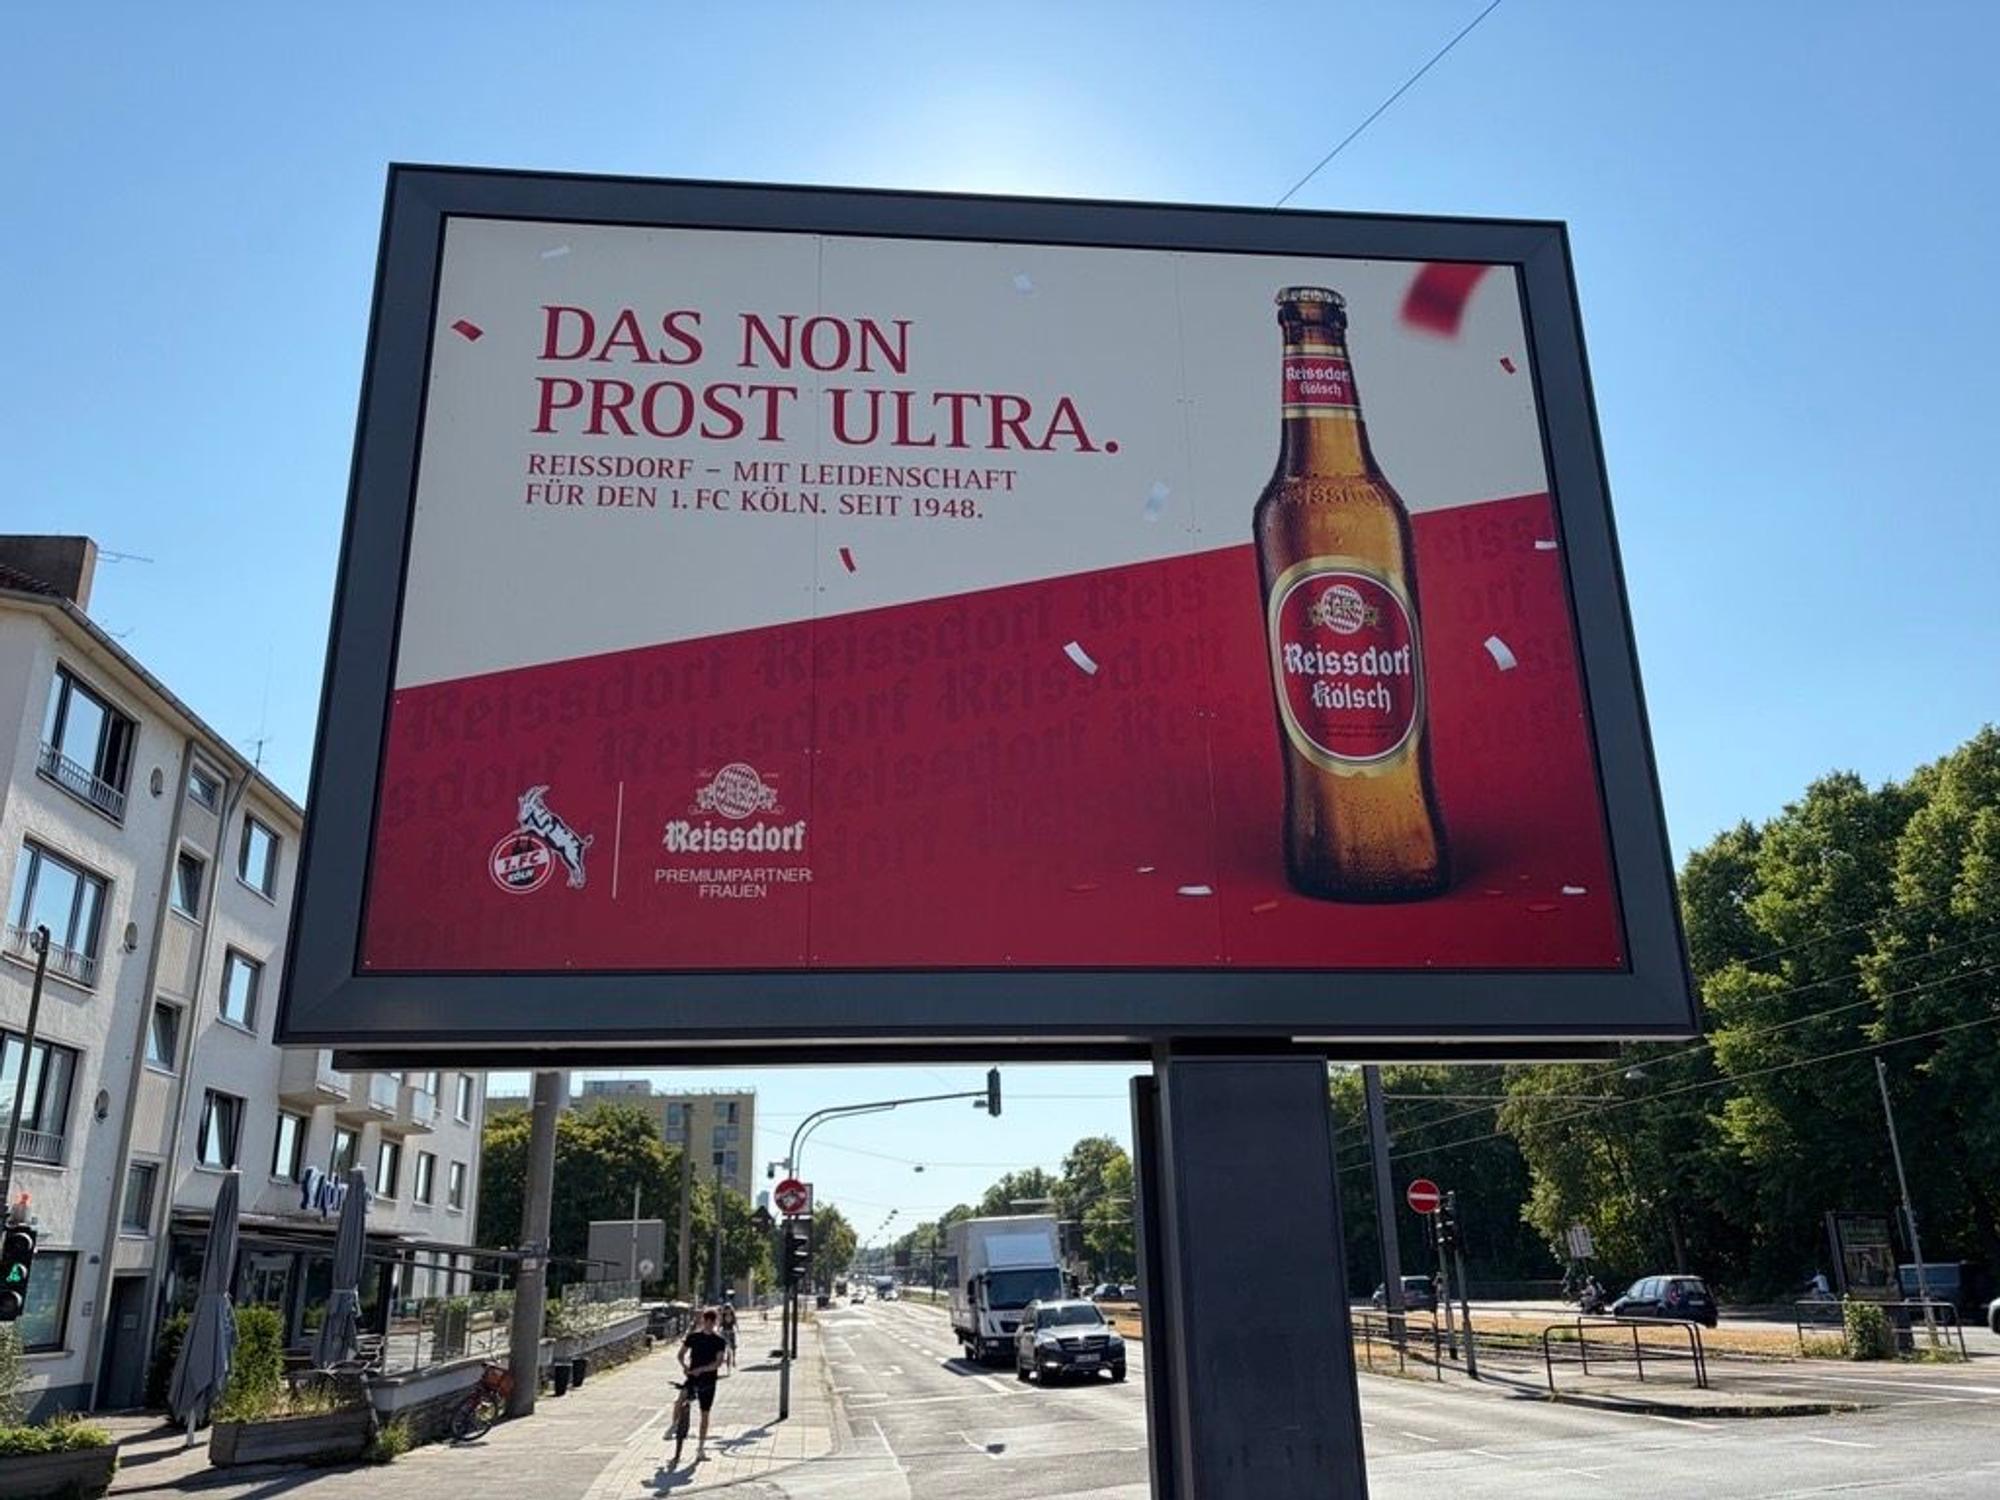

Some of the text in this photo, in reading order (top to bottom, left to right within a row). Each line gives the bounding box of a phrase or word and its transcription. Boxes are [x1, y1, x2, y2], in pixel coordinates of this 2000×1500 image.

[537, 304, 912, 374] DAS NON
[529, 376, 1121, 454] PROST ULTRA.
[527, 453, 694, 480] REISSDORF
[734, 460, 790, 483] MIT
[800, 463, 1017, 491] LEIDENSCHAFT
[525, 478, 584, 506] FÜR
[596, 485, 657, 508] DEN
[695, 488, 730, 511] FC
[741, 486, 827, 514] KÖLN.
[839, 494, 902, 517] SEIT
[912, 497, 983, 519] 1948.
[1284, 642, 1411, 676] Reissdorf
[1312, 680, 1391, 714] Kölsch
[663, 820, 807, 853] Reissdorf
[655, 868, 813, 882] PREMIUMPARTNER
[700, 884, 767, 898] FRAUEN
